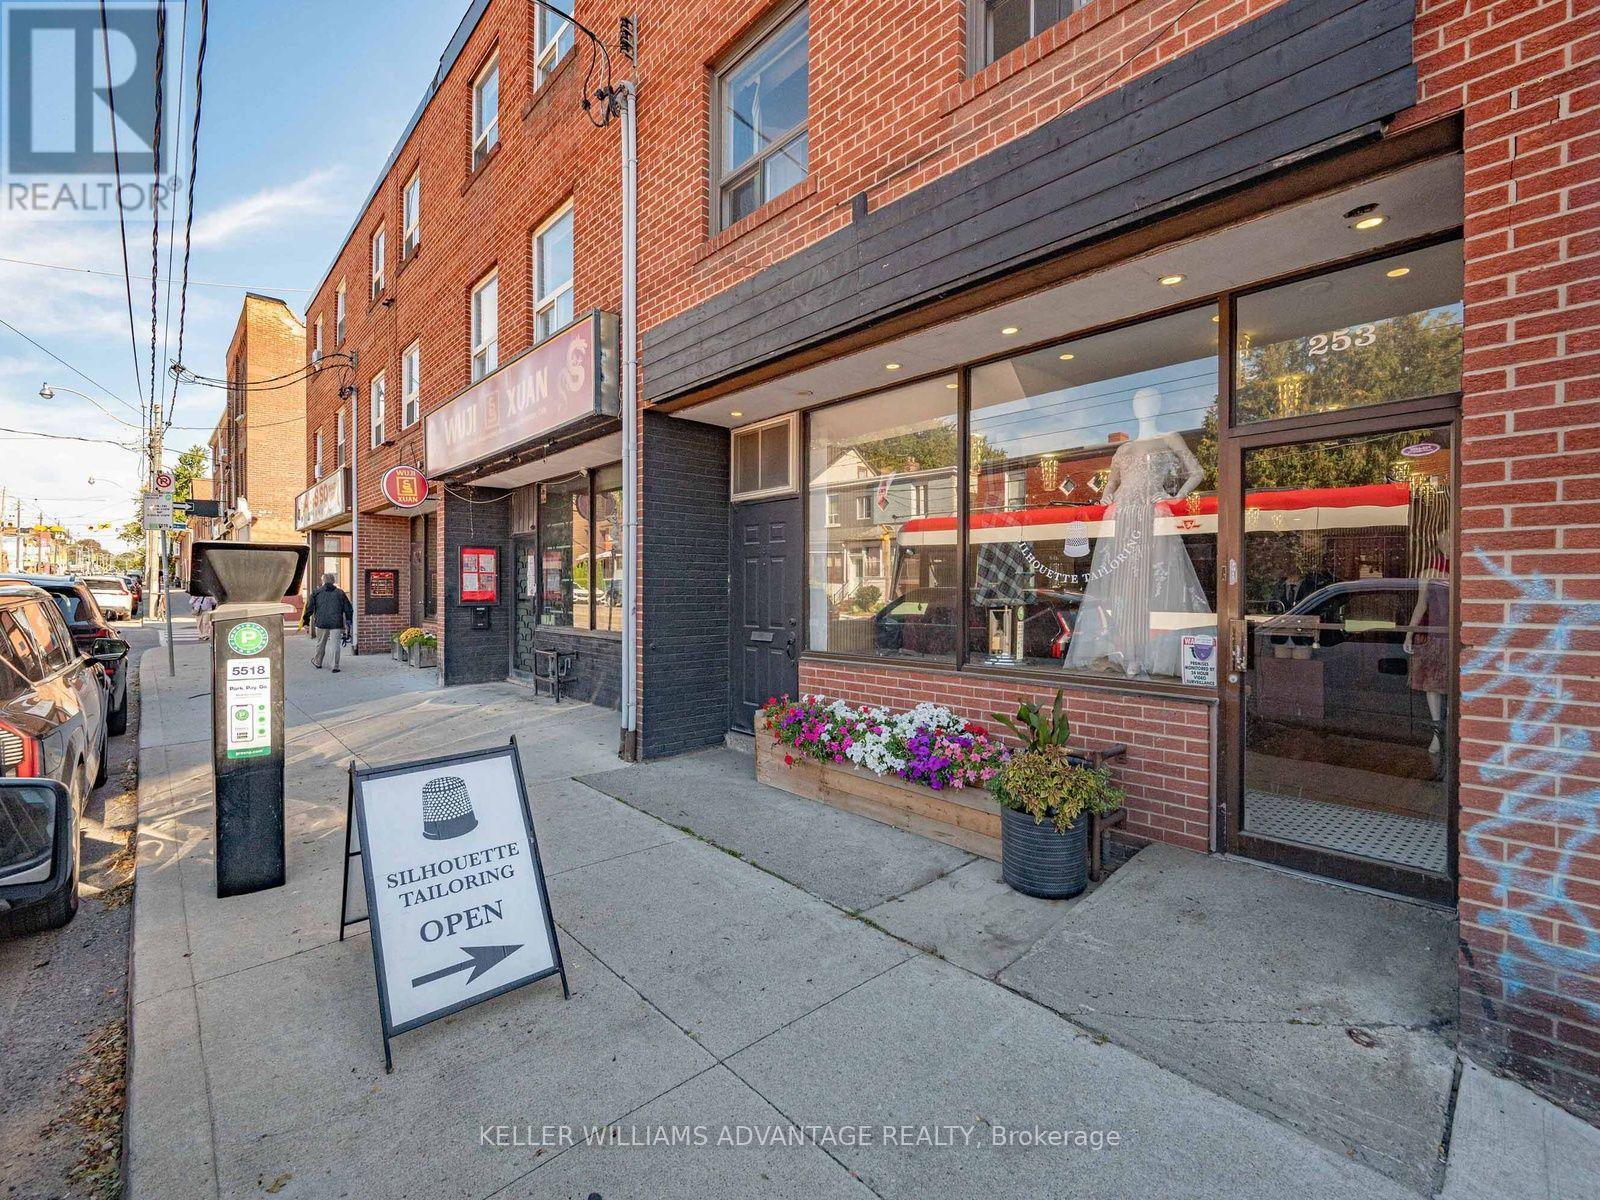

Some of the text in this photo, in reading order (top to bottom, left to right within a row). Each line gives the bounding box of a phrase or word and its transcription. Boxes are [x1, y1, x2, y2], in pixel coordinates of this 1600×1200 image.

[1308, 324, 1376, 357] 253
[444, 366, 549, 446] WUJI XUAN
[395, 469, 416, 477] WUJI
[1017, 529, 1142, 584] ILHOUETTE TAILORING
[232, 665, 266, 676] 5518
[386, 842, 521, 889] SILHOUETTE
[398, 864, 516, 908] TAILORING
[419, 899, 504, 943] OPEN
